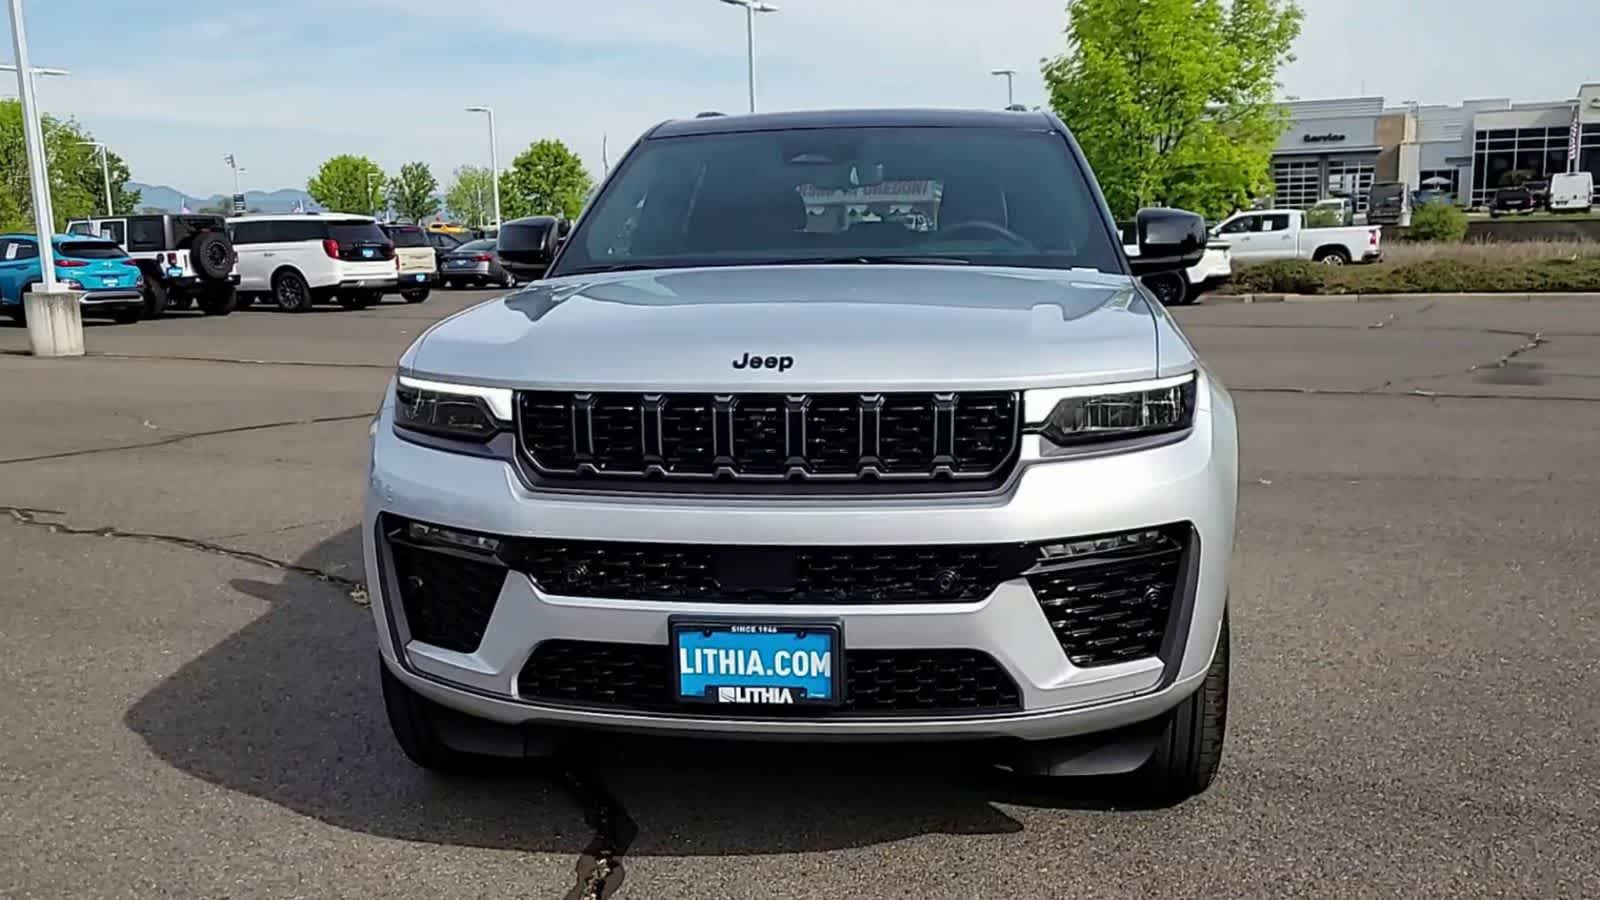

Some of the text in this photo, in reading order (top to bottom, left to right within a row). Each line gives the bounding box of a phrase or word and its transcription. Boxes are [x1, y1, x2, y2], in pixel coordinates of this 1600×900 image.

[1303, 132, 1346, 143] Service
[732, 352, 794, 372] Jeep
[730, 625, 756, 633] SINCE
[679, 648, 831, 677] LITHIA.COM
[735, 687, 794, 704] LITHIA
